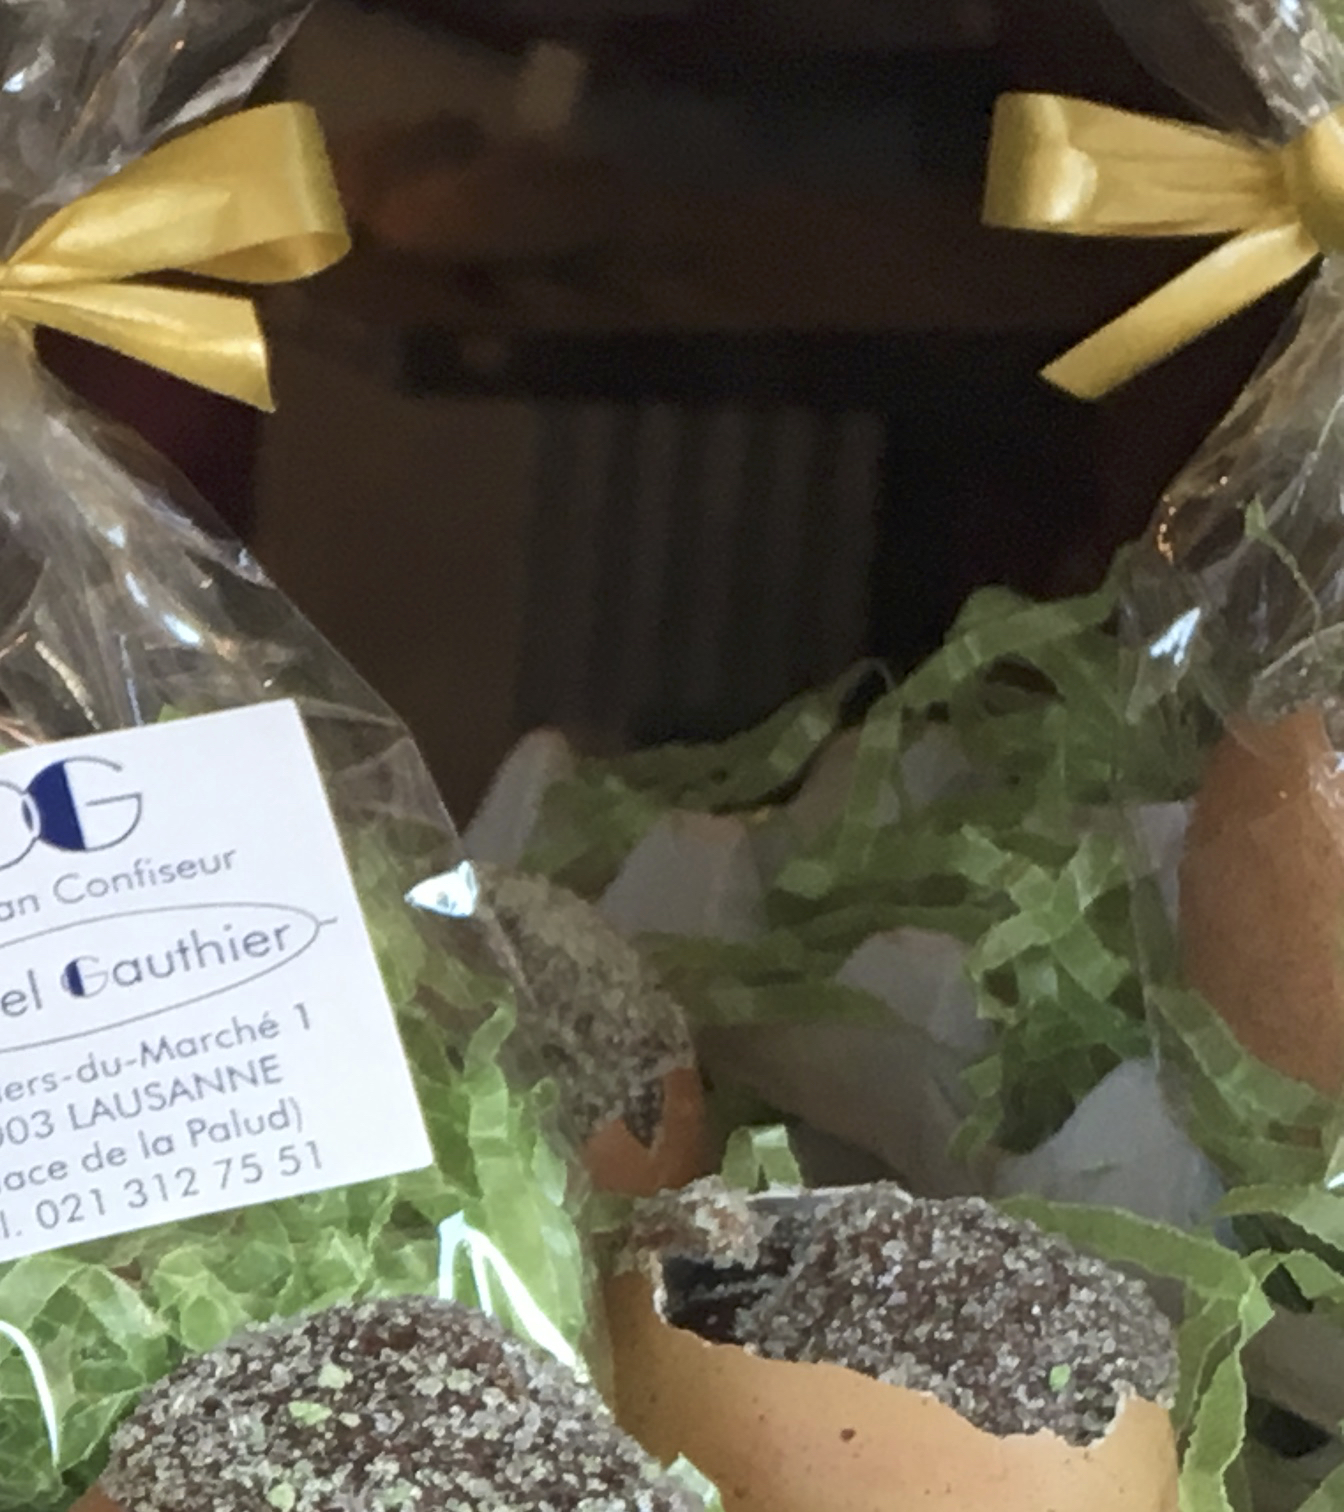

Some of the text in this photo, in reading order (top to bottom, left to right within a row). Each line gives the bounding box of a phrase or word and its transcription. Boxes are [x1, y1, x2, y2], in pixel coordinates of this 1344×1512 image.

[53, 849, 236, 906] Confiseur
[60, 923, 291, 999] Gauthier
[295, 1002, 312, 1033] 1
[68, 1055, 282, 1131] LAUSANNE
[82, 1140, 127, 1173] de
[141, 1131, 175, 1159] la
[187, 1097, 304, 1150] Palud)
[37, 1189, 105, 1231] 021
[124, 1168, 199, 1211] 312
[212, 1155, 262, 1191] 75
[280, 1140, 323, 1176] 51
